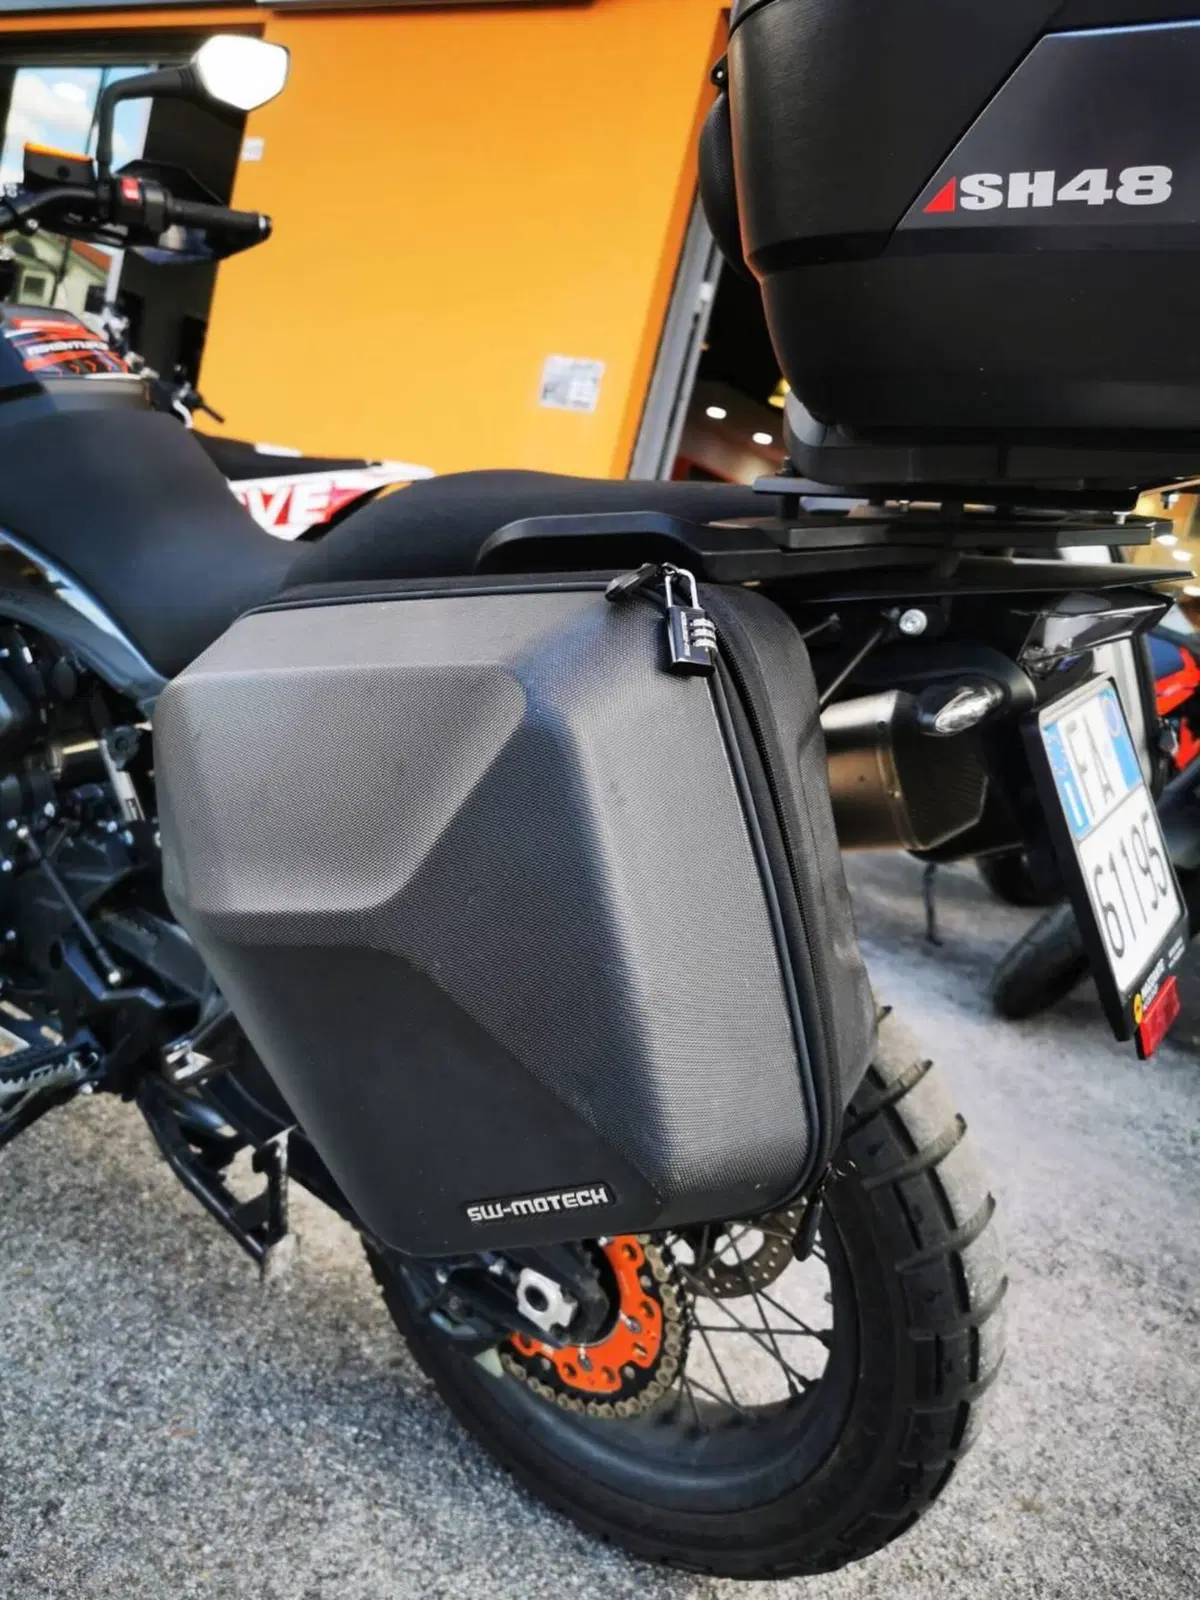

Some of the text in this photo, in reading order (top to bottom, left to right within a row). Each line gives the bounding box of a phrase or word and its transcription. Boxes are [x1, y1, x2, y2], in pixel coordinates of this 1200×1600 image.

[960, 165, 1173, 211] SH48
[1094, 811, 1168, 959] 61195
[466, 1187, 609, 1222] SW-MOTECH
